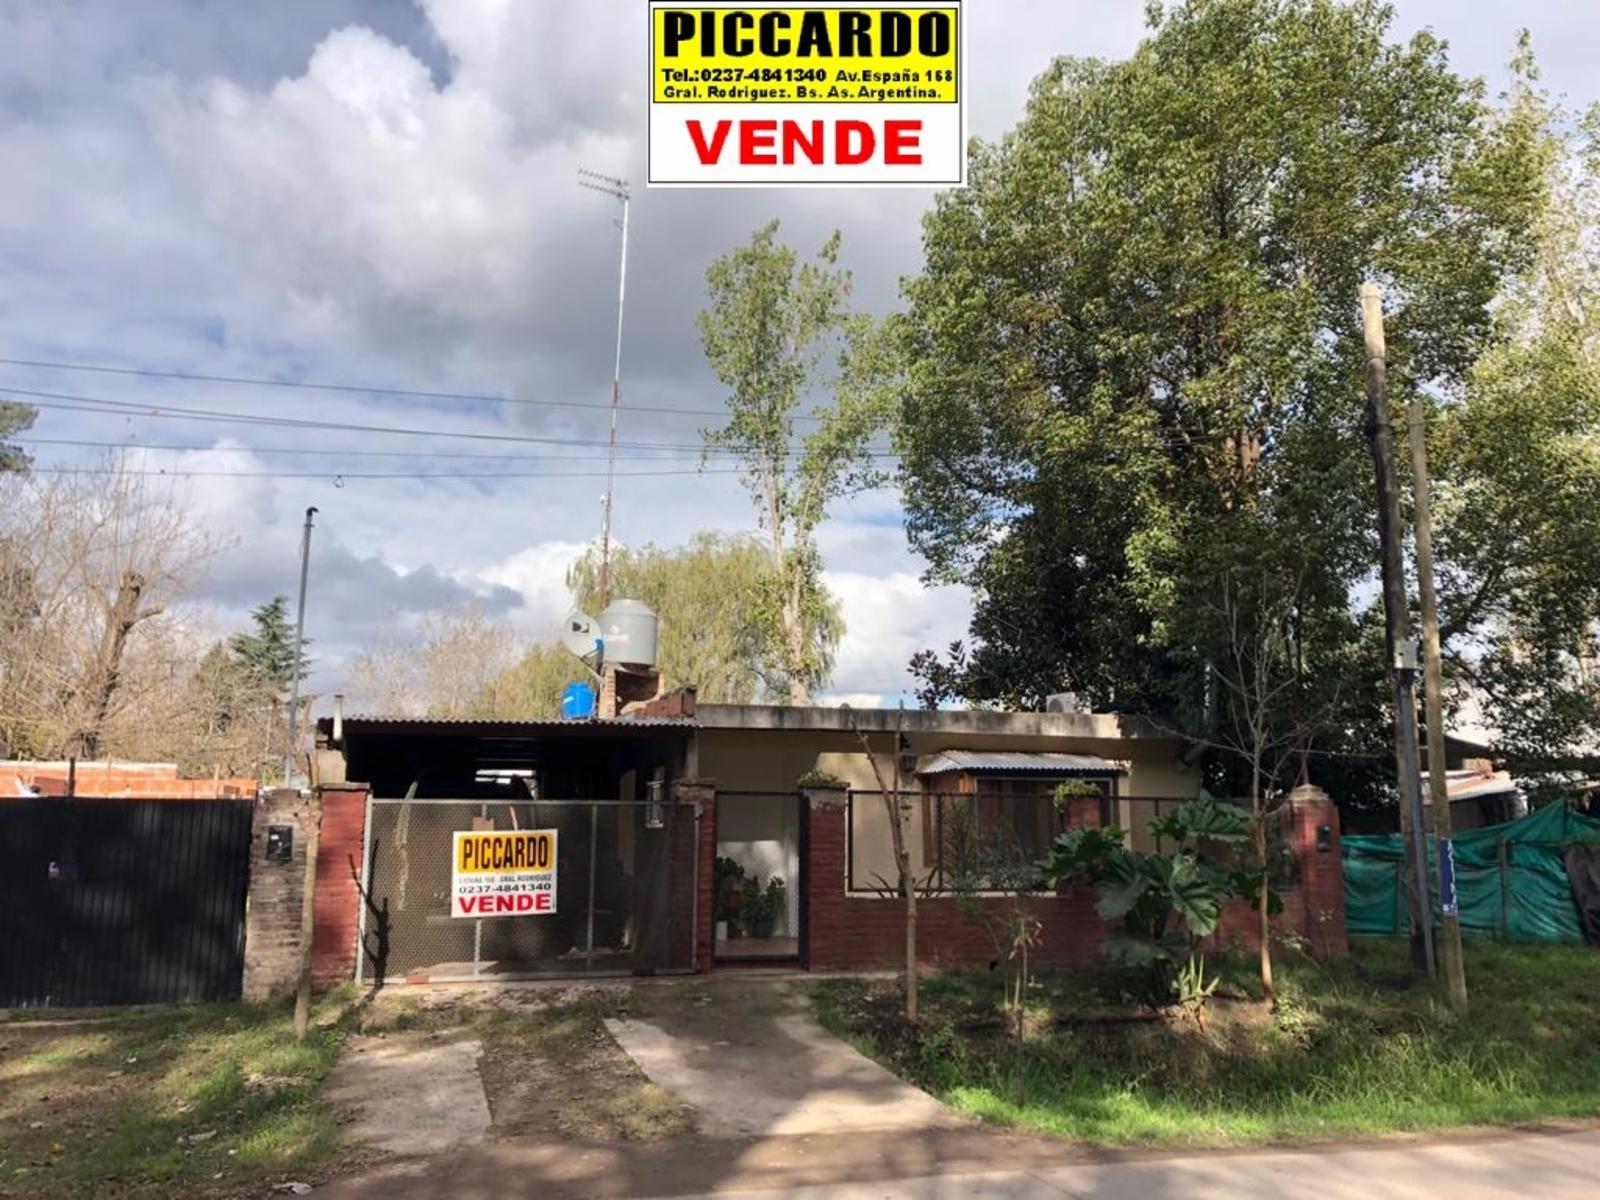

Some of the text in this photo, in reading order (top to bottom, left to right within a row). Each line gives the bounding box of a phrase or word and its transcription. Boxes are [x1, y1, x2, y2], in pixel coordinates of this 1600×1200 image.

[463, 836, 548, 869] PICCARDO
[459, 883, 551, 894] 0237-4841340
[458, 893, 551, 913] VENDE
